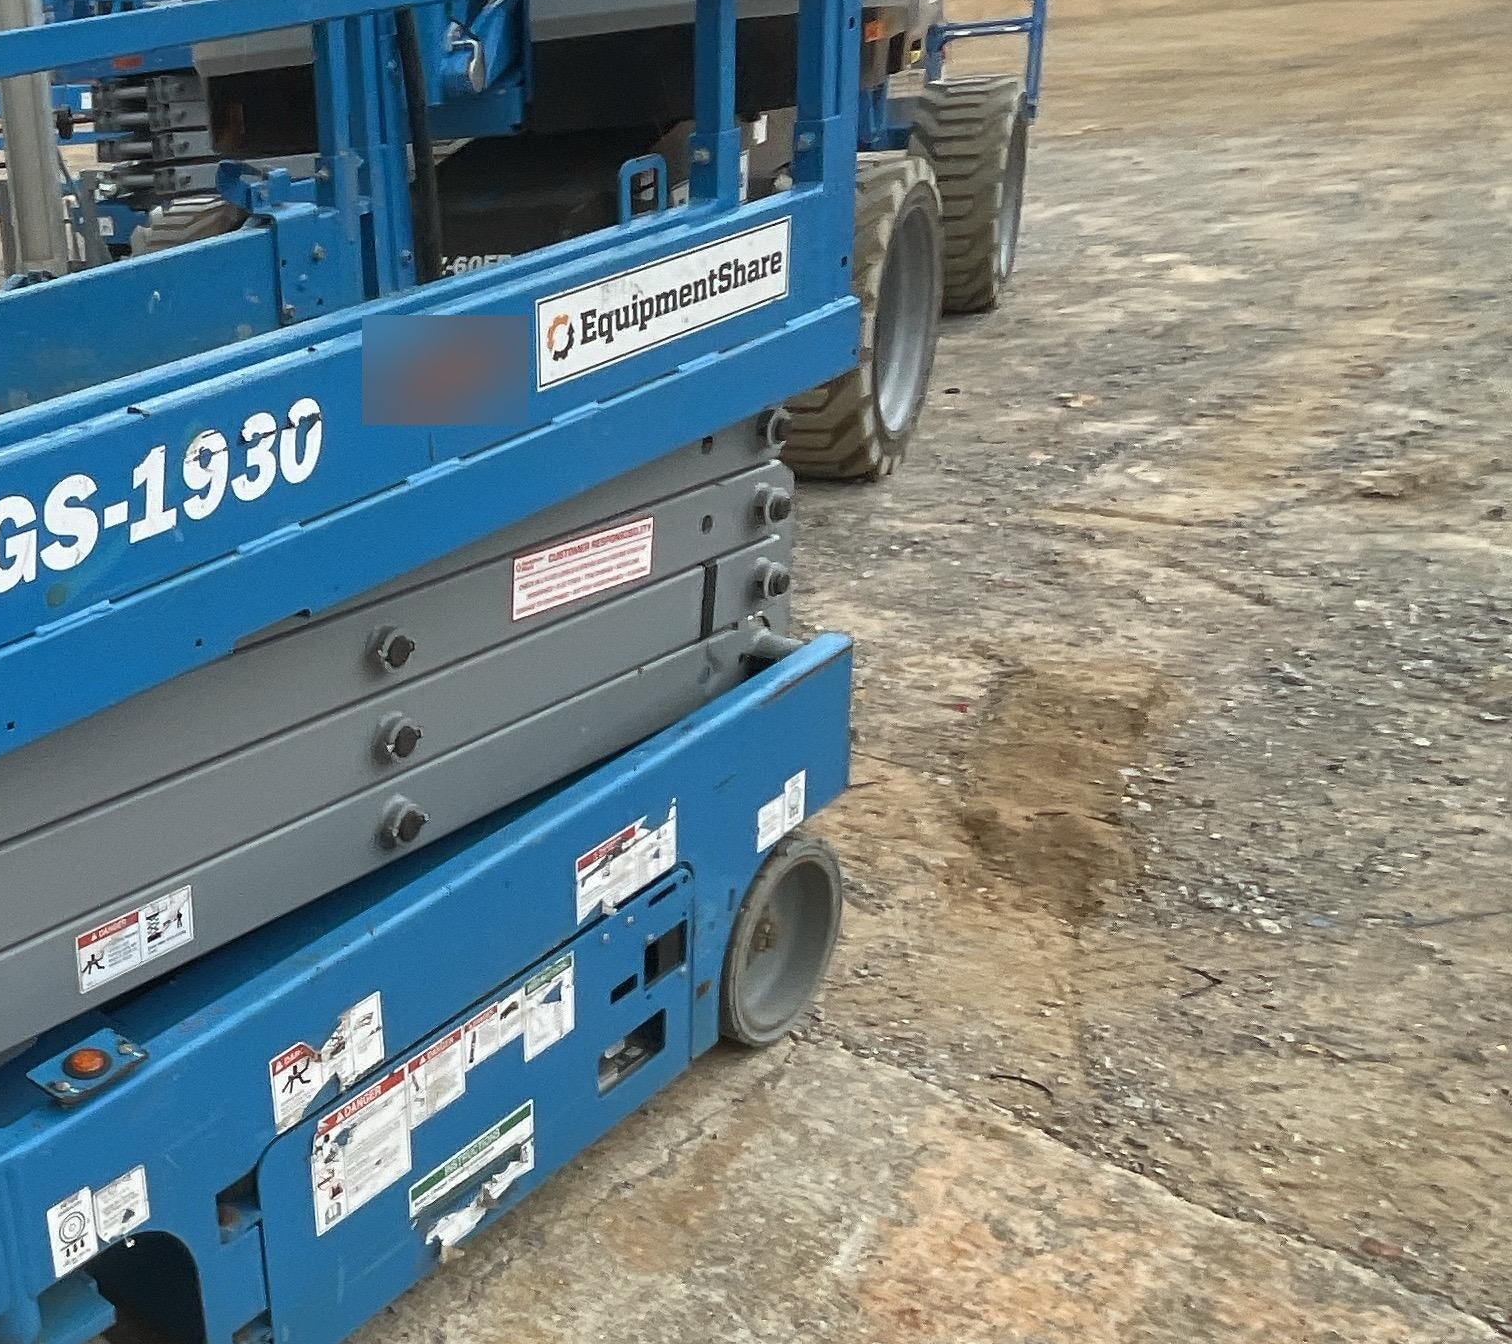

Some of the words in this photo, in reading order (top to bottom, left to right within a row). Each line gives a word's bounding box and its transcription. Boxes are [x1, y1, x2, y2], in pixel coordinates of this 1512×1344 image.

[579, 251, 782, 345] EquipmentShare
[98, 918, 127, 939] DANGER
[343, 1084, 382, 1118] DANGER
